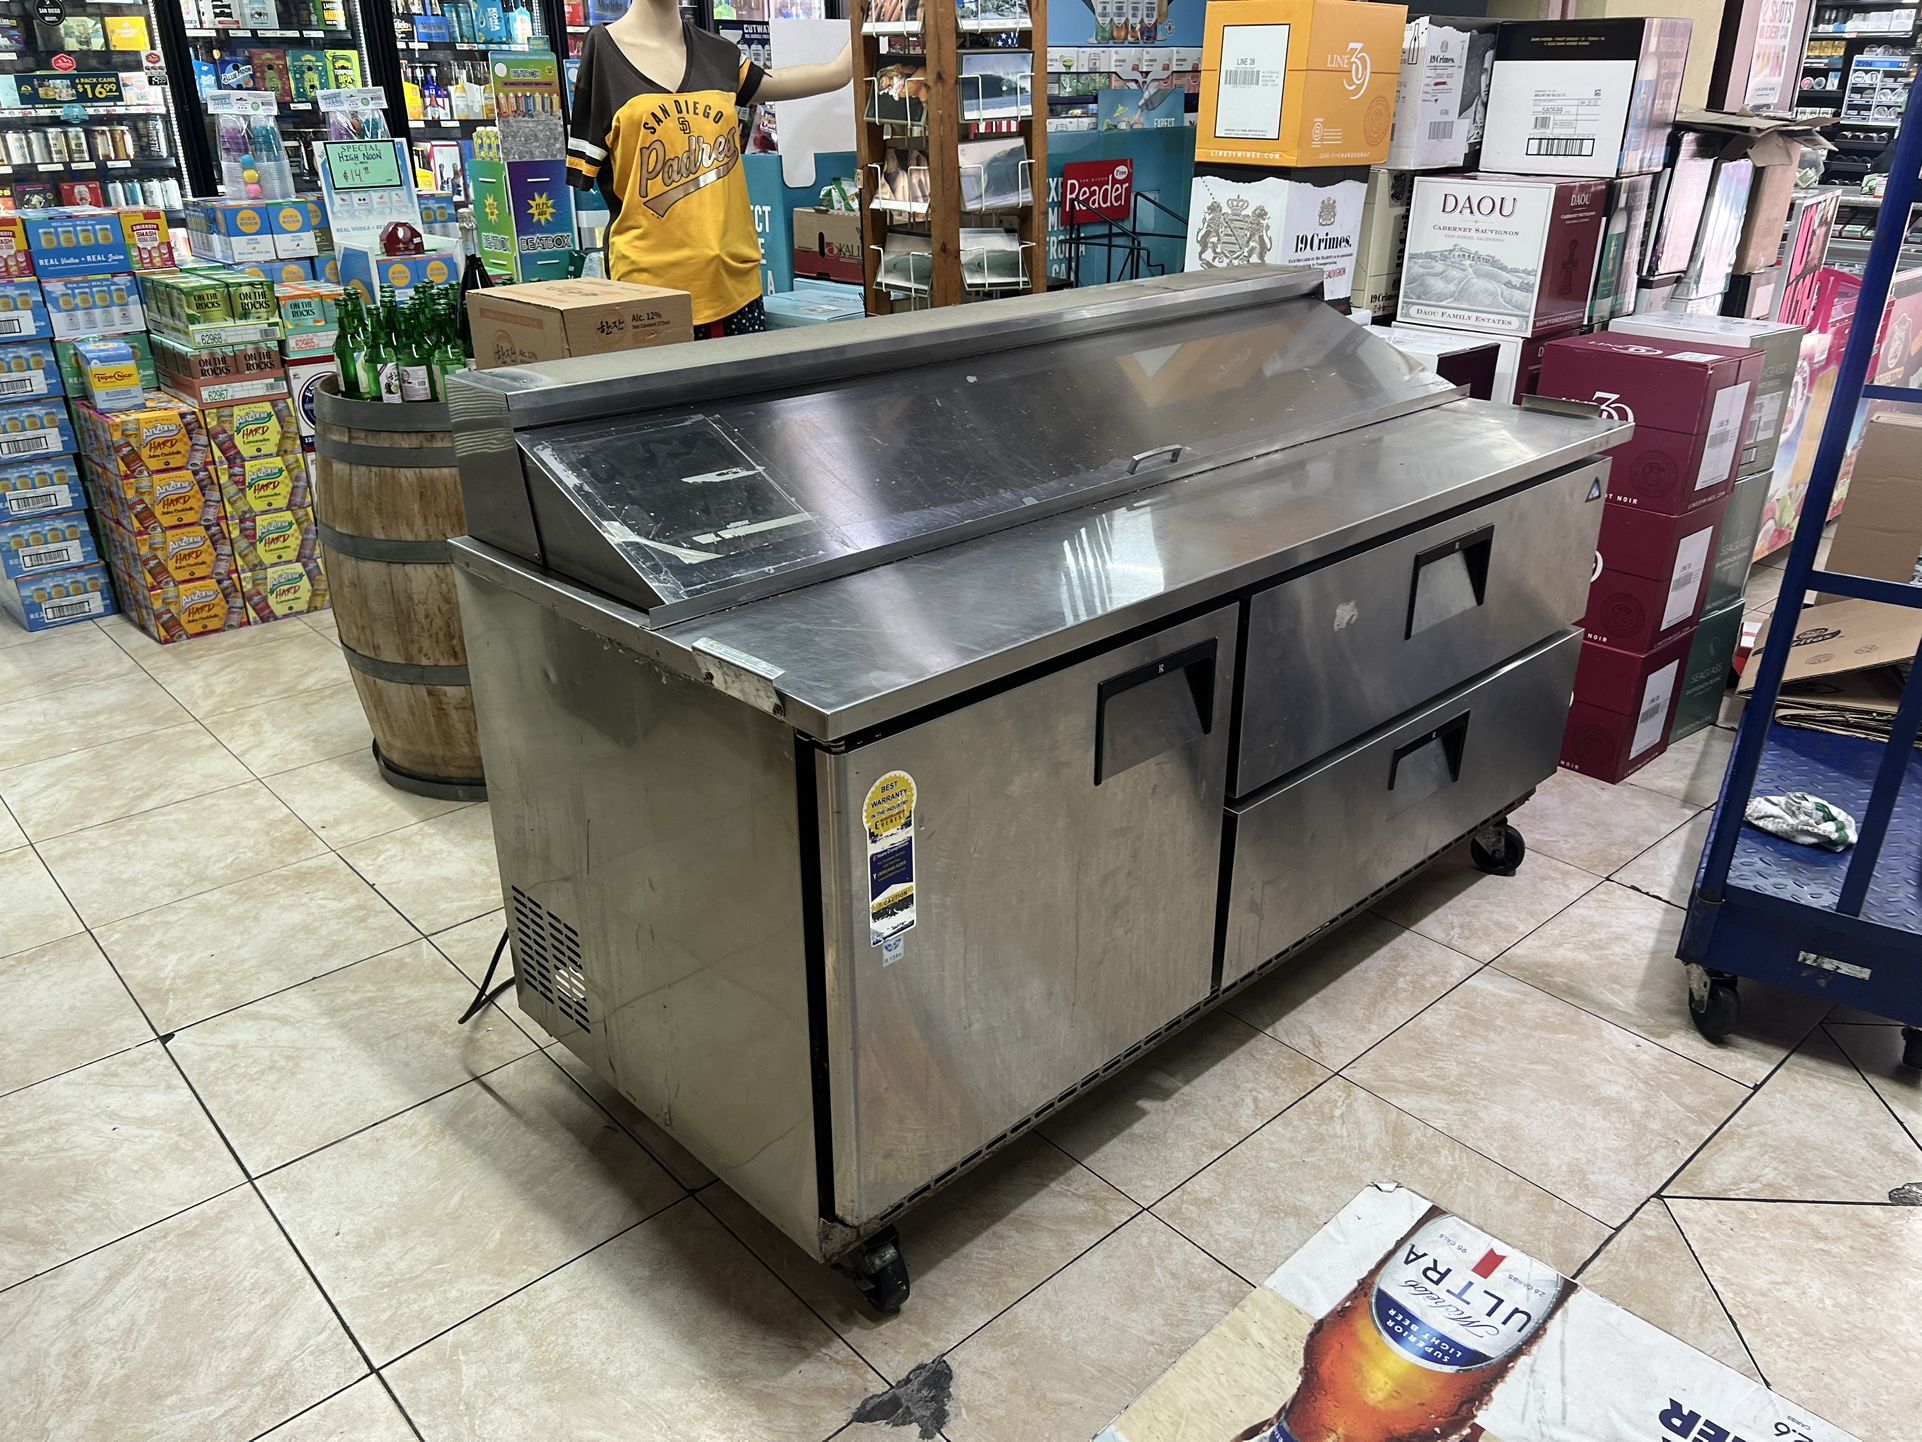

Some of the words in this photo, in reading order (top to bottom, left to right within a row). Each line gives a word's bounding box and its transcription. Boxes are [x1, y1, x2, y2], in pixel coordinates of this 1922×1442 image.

[491, 8, 500, 31] KONA
[743, 24, 769, 33] CUTWAT
[1327, 54, 1351, 68] LINE
[222, 72, 237, 84] BLUE
[237, 65, 253, 78] MOON
[643, 103, 670, 134] SAN
[674, 99, 724, 125] DIEGO
[341, 144, 380, 152] SPECIAL
[338, 151, 359, 162] HIGH
[363, 151, 382, 161] NOON
[639, 126, 739, 198] Padres
[1066, 174, 1129, 212] Reader
[1570, 193, 1592, 206] DAOU
[1442, 193, 1517, 218] DAOU
[136, 230, 157, 238] SMASH
[1432, 224, 1472, 233] CABERNET
[1475, 227, 1519, 236] SAUVIGNON
[520, 234, 571, 251] BEATBOX
[1294, 234, 1308, 253] 19
[39, 257, 59, 266] REAL
[86, 254, 106, 262] REAL
[193, 293, 204, 302] ON
[205, 292, 218, 301] THE
[239, 291, 251, 301] ON
[253, 290, 268, 299] THE
[195, 301, 221, 311] ROCKS
[241, 299, 270, 310] ROCKS
[290, 302, 300, 310] ON
[301, 301, 313, 309] THE
[291, 308, 316, 318] ROCKS
[631, 314, 645, 323] Alc.
[646, 312, 662, 320] 12%
[1416, 308, 1438, 317] DAOU
[1440, 311, 1473, 322] FAMILY
[1475, 315, 1513, 327] ESTATES
[201, 333, 223, 344] 62968
[294, 340, 316, 349] 62965
[199, 358, 211, 367] ON
[213, 356, 228, 366] THE
[244, 353, 256, 362] ON
[258, 351, 274, 361] THE
[201, 366, 230, 378] ROCKS
[246, 361, 275, 371] ROCKS
[94, 373, 114, 382] Topo
[114, 371, 134, 381] Chico
[207, 389, 228, 400] 62967
[242, 426, 269, 439] HARD
[149, 438, 178, 453] HARD
[253, 480, 281, 494] HARD
[162, 494, 191, 509] HARD
[1616, 495, 1638, 504] NOIR
[264, 533, 290, 547] HARD
[175, 549, 203, 563] HARD
[275, 585, 301, 599] HARD
[188, 602, 215, 618] HARD
[1587, 633, 1608, 642] NOIR
[881, 781, 897, 793] BEST
[871, 788, 907, 808] WARRANTY
[883, 891, 908, 906] CAUTION
[1457, 1245, 1467, 1254] 95
[1402, 1243, 1532, 1333] ULTRA
[1507, 1273, 1533, 1291] CARBS
[1398, 1279, 1500, 1338] Michelob
[1388, 1307, 1420, 1332] BEER
[1386, 1319, 1450, 1362] SUPERIOR
[1421, 1332, 1462, 1358] LIGHT
[1787, 1415, 1811, 1431] CARBS
